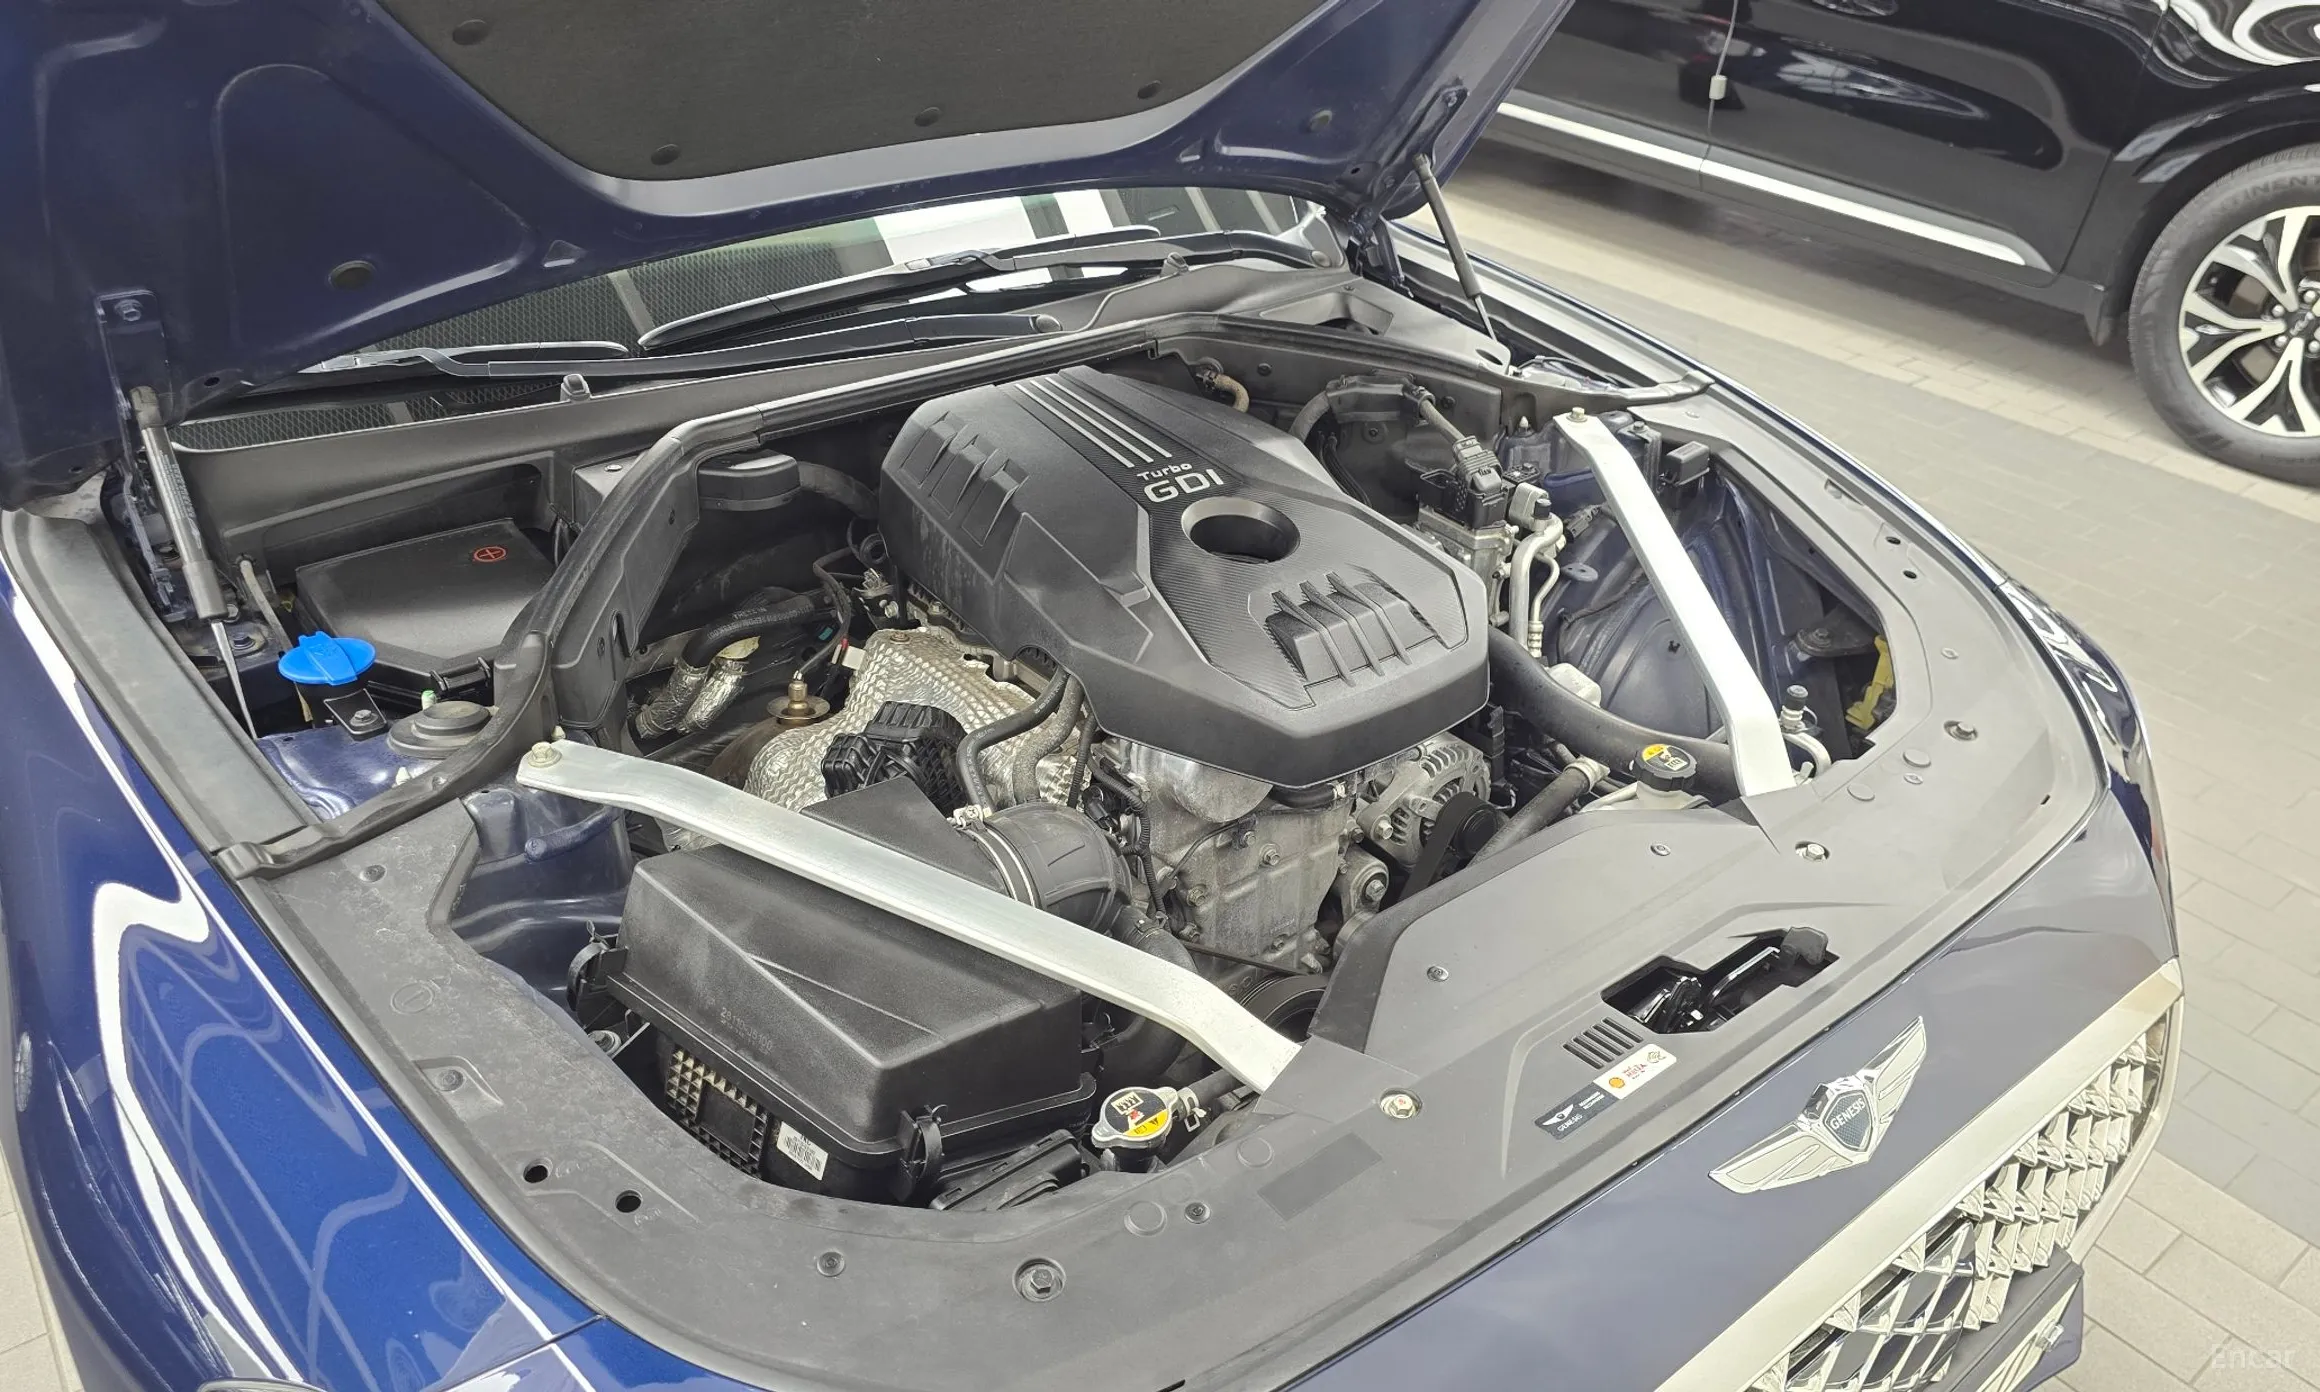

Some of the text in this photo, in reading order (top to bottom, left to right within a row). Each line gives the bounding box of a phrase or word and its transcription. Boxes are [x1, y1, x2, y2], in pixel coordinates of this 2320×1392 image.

[1137, 463, 1193, 481] Turbo
[1143, 468, 1224, 503] GDI
[1830, 1097, 1866, 1130] GENESIS
